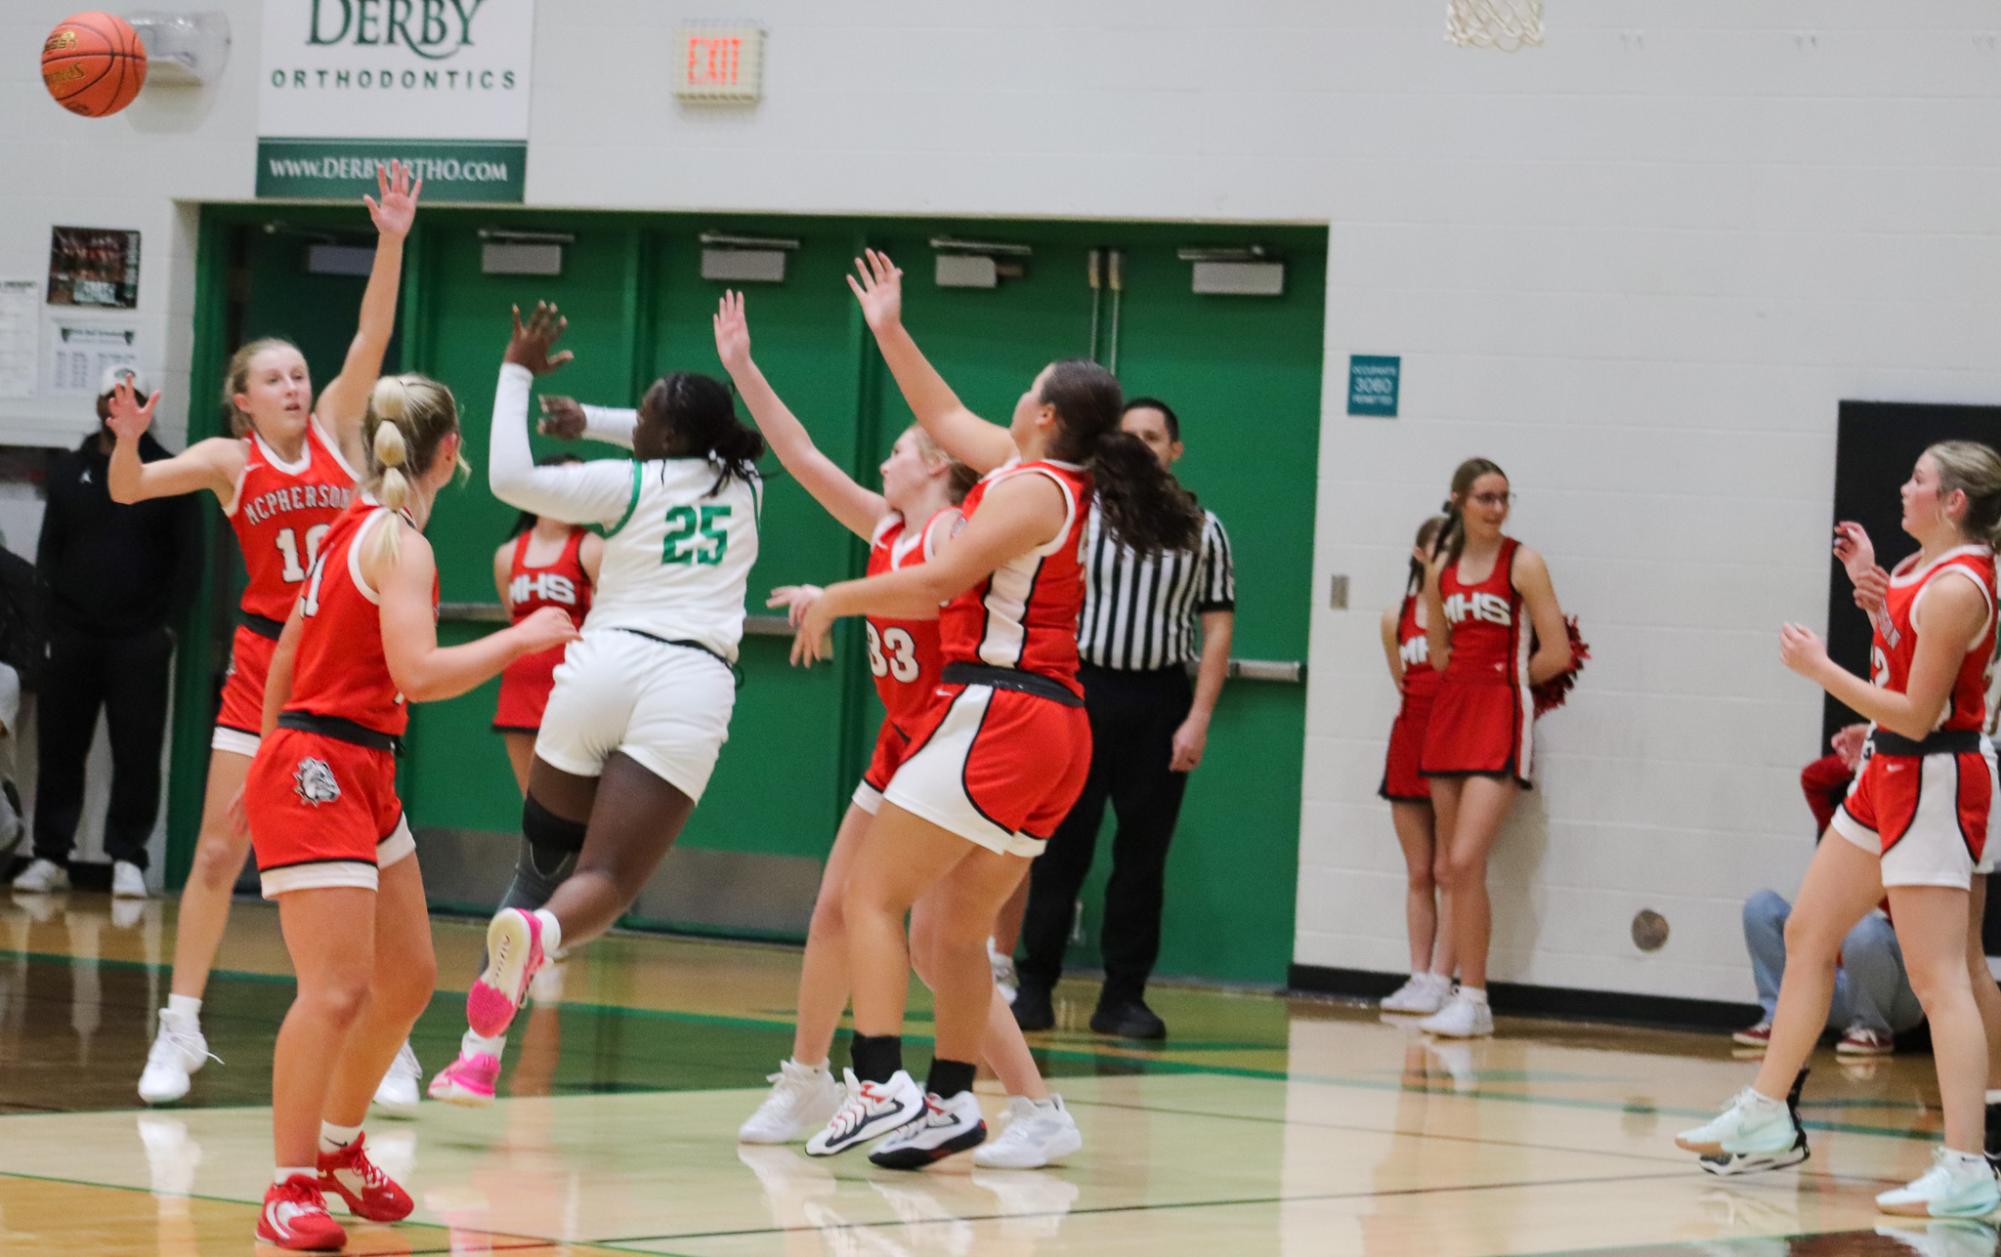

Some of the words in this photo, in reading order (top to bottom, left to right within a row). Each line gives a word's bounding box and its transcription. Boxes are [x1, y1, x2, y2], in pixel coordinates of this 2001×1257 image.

[305, 0, 484, 60] DERBY
[271, 69, 516, 89] ORTHODONTICS
[688, 37, 743, 85] EXIT
[243, 484, 351, 525] MCPHERSON
[661, 505, 732, 566] 25
